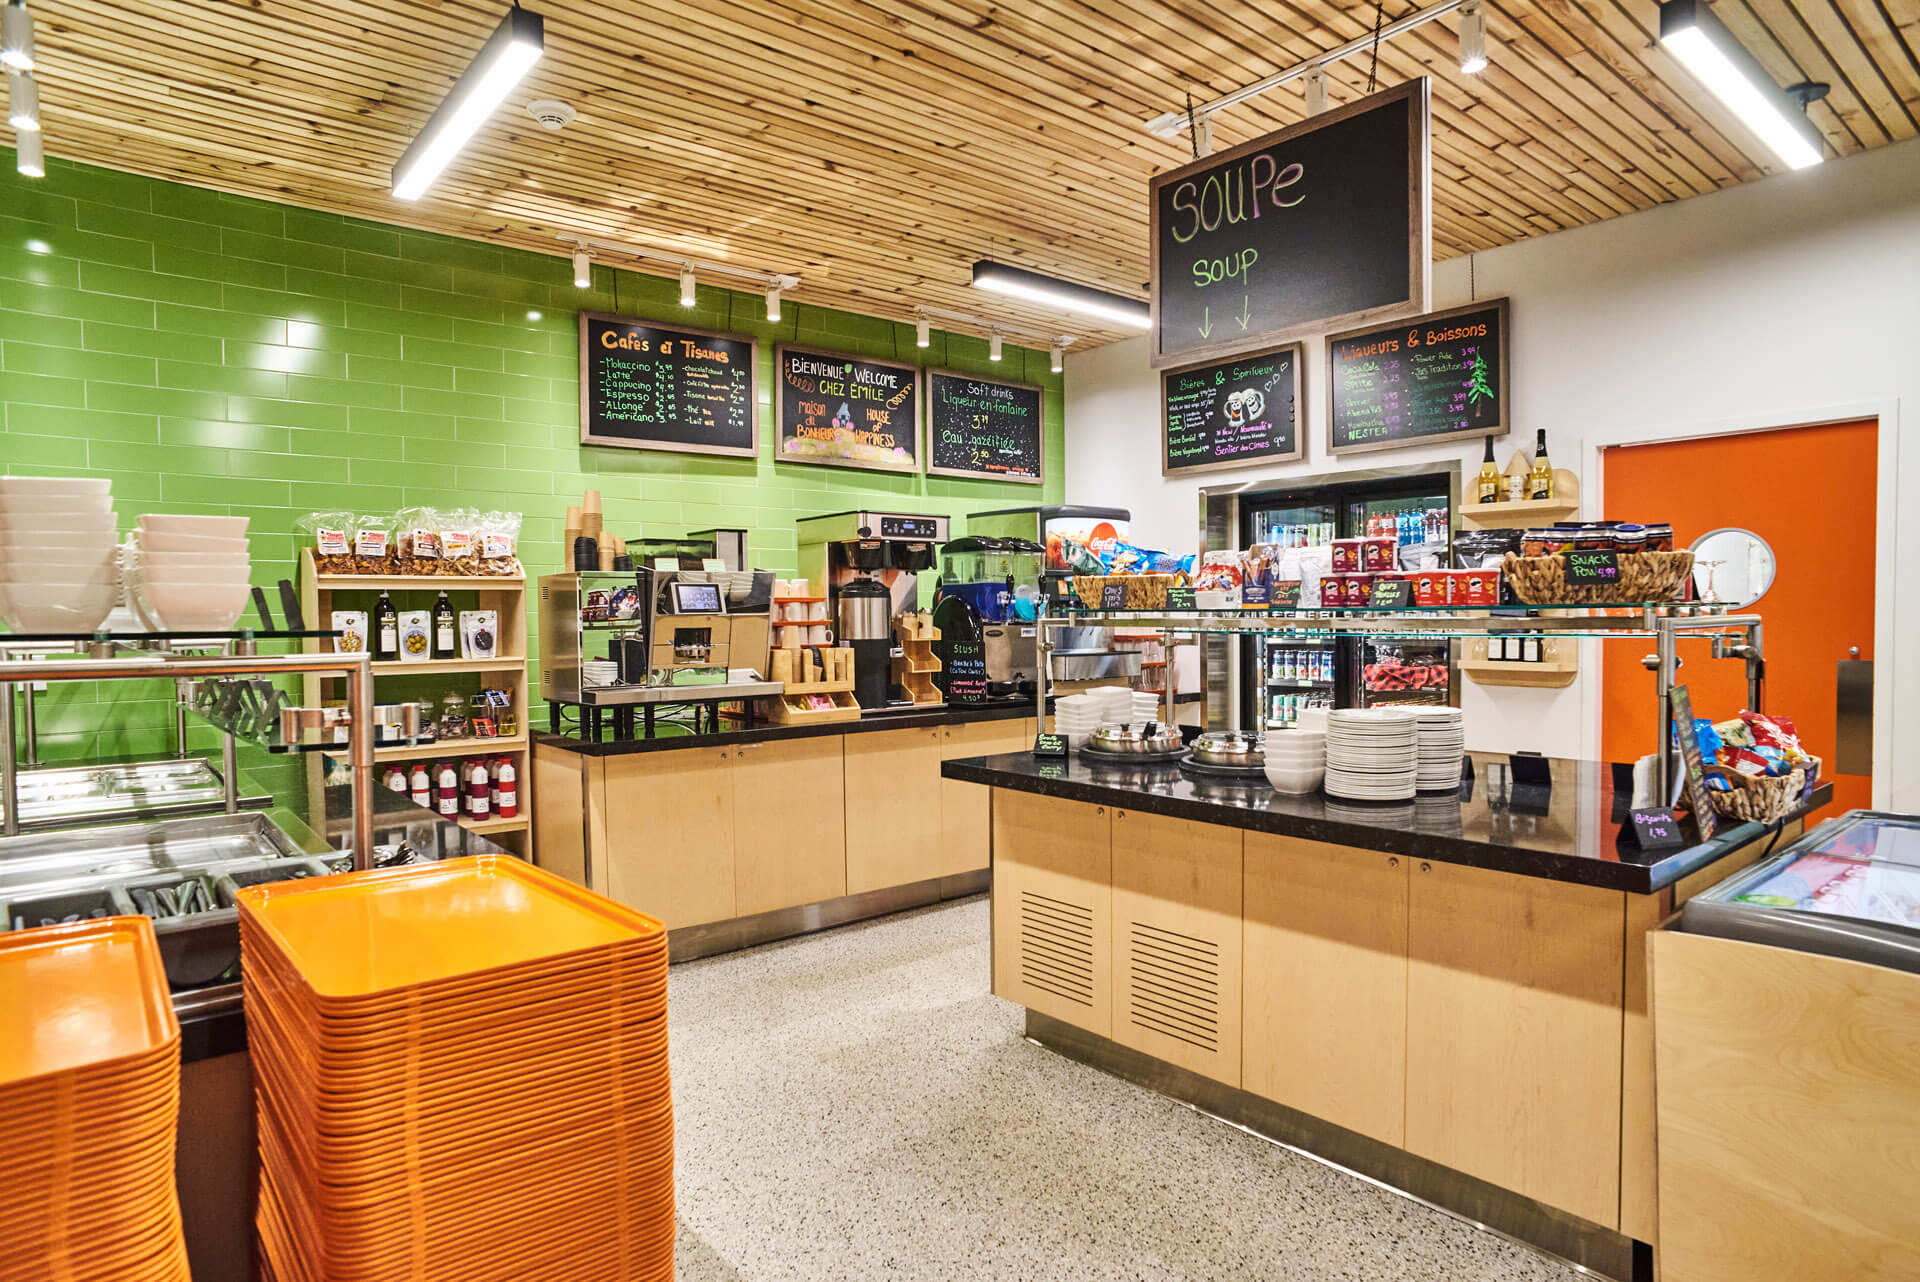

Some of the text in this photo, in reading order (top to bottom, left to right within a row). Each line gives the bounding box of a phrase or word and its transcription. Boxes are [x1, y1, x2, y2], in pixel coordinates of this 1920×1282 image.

[1407, 330, 1420, 347] &
[1427, 323, 1487, 345] Boissons
[680, 340, 729, 363] Tisanes
[606, 358, 650, 372] Mokaccino
[854, 368, 897, 388] WELCOME
[1216, 371, 1226, 385] &
[606, 390, 650, 402] Espresso
[820, 380, 845, 396] CHEZ
[967, 382, 1014, 400] Soft drinks
[942, 388, 1028, 416] Liqueur en fontaine
[867, 408, 891, 425] HOUSE
[797, 425, 835, 441] BONHEUR
[943, 430, 963, 444] Eau
[1570, 555, 1611, 565] SNACK
